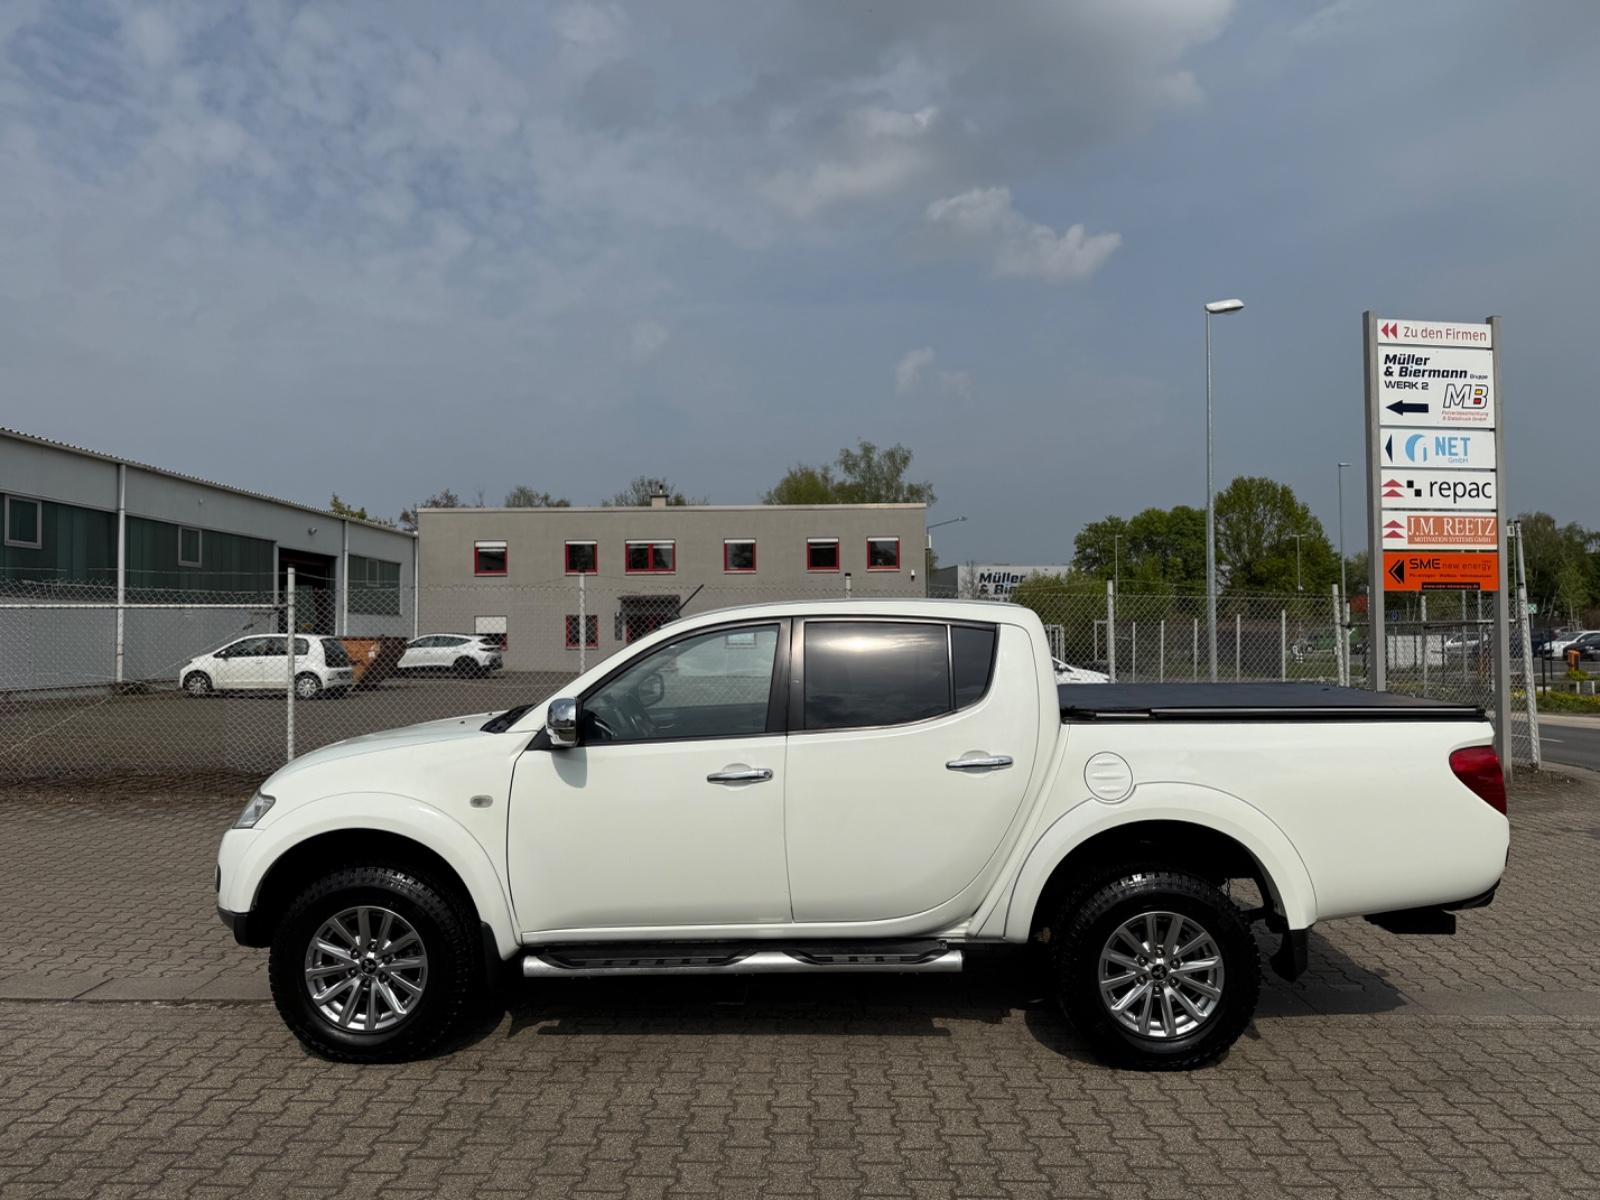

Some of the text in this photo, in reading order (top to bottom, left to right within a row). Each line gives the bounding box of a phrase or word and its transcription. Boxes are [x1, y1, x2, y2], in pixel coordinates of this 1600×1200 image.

[1404, 326, 1487, 341] Zu den Firmen
[1384, 354, 1430, 366] Müller
[1384, 366, 1394, 377] &
[1399, 366, 1468, 379] Biermann
[1384, 380, 1429, 390] WERK 2
[1443, 384, 1489, 409] MB
[1435, 437, 1471, 457] NET
[1429, 480, 1492, 504] repac
[1408, 518, 1496, 536] J.M. REETZ
[1409, 558, 1441, 570] SME
[979, 572, 1026, 584] Müller
